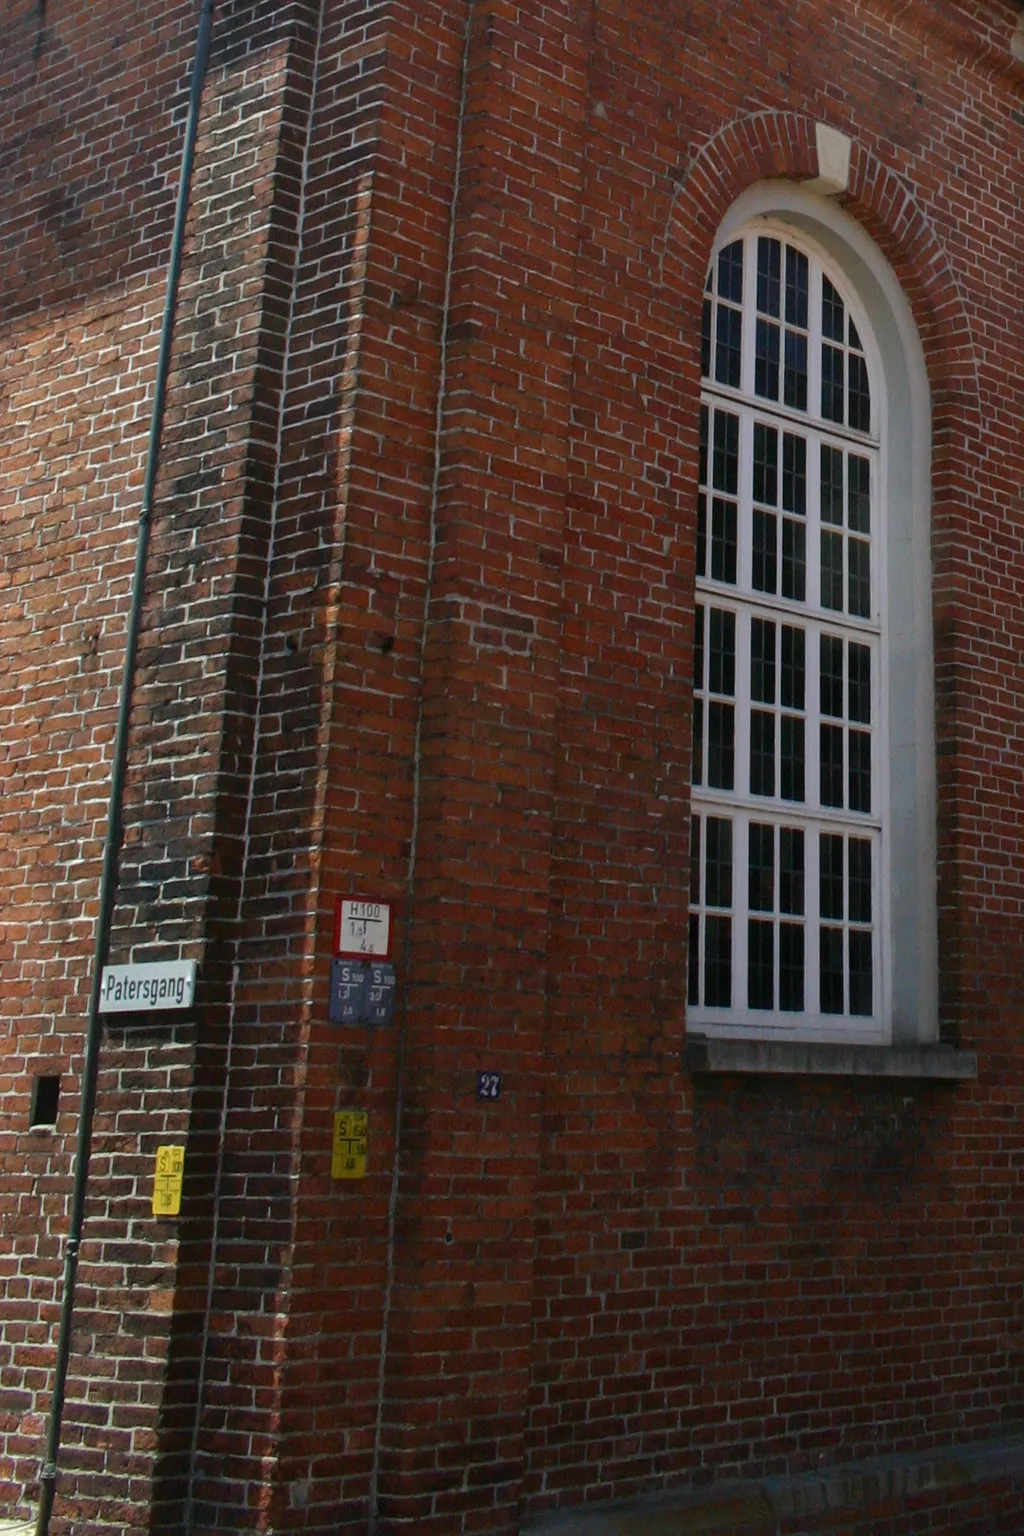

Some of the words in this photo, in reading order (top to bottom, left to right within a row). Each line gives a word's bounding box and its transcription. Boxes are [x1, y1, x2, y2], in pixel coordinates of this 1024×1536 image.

[341, 967, 350, 982] S
[373, 969, 382, 984] S
[106, 974, 185, 1006] Patersgang
[480, 1074, 500, 1097] 27
[339, 1120, 347, 1136] S
[159, 1156, 166, 1171] S
